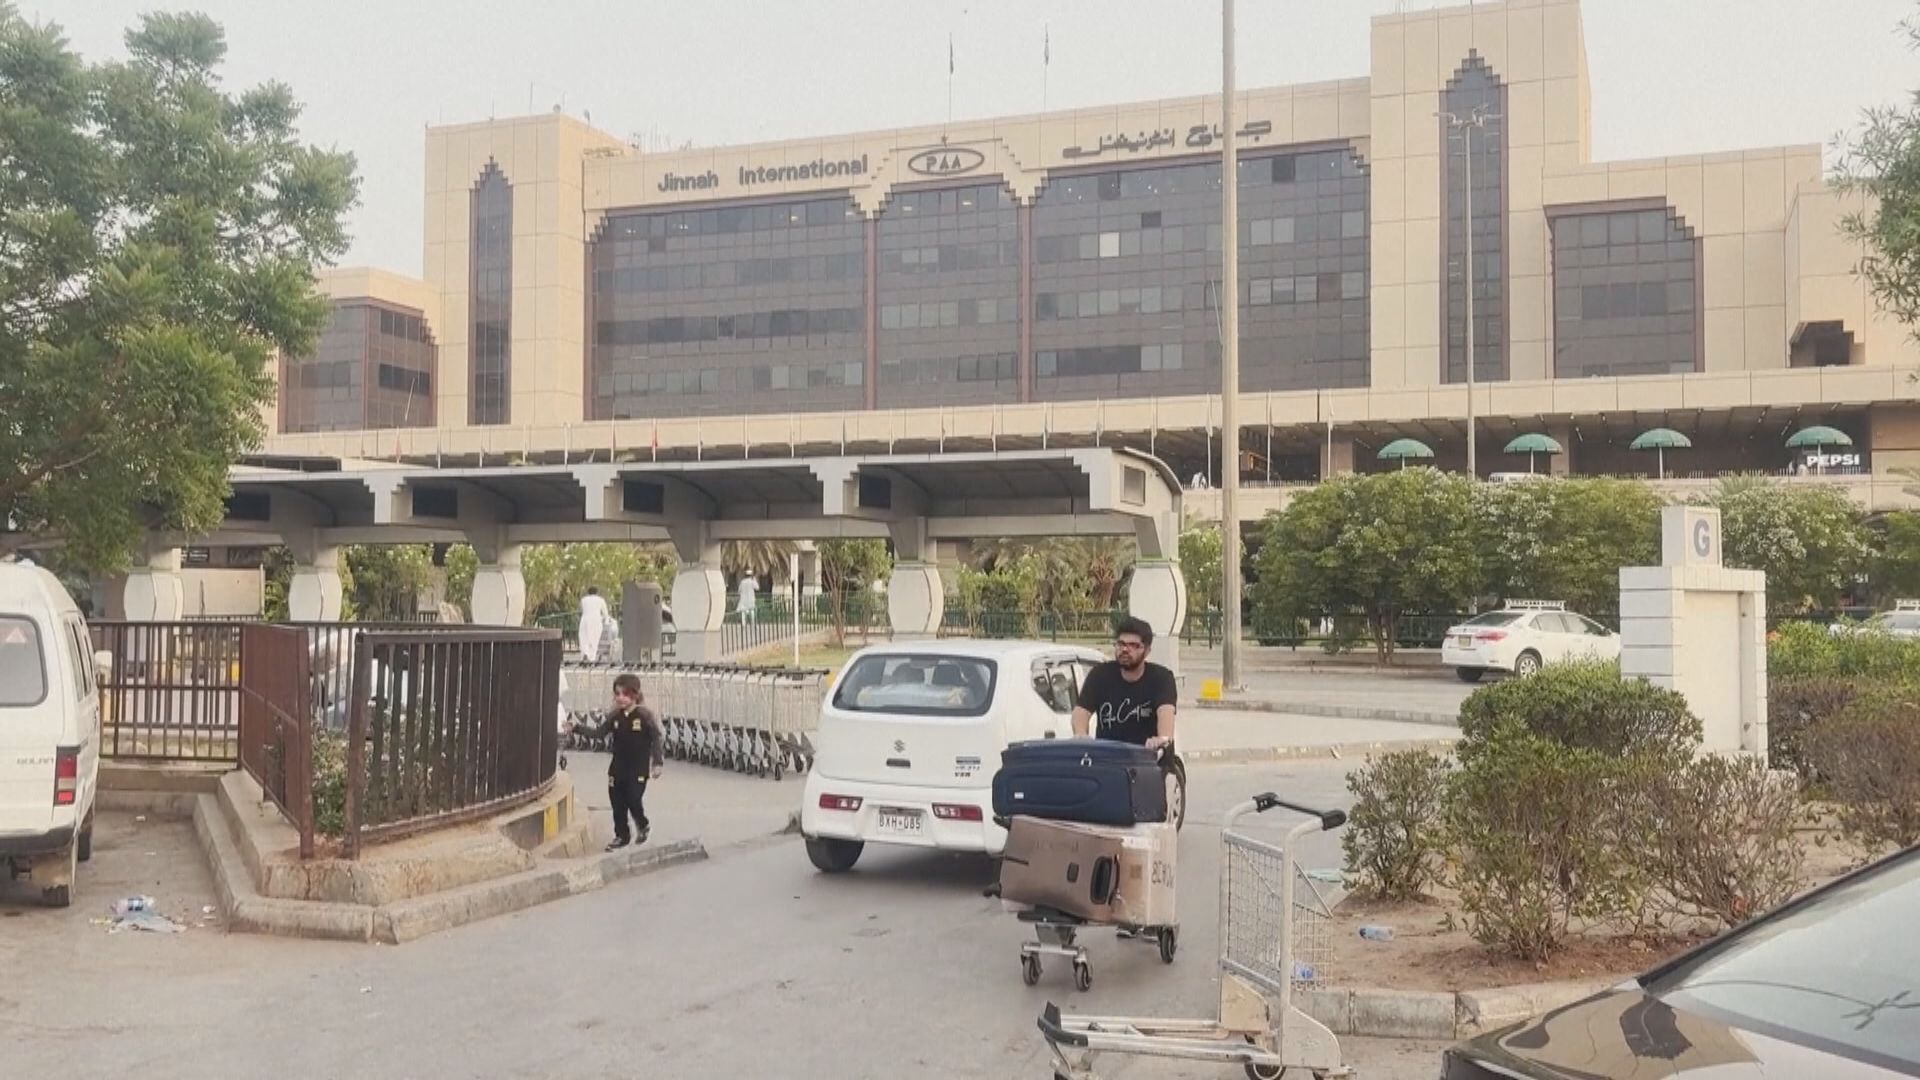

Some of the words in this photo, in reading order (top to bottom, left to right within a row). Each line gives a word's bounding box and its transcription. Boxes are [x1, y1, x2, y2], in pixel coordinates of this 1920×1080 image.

[658, 170, 719, 192] Jinnah
[738, 154, 868, 185] International
[925, 153, 962, 171] PAA
[1806, 454, 1860, 468] PEPSI
[1693, 519, 1710, 557] G
